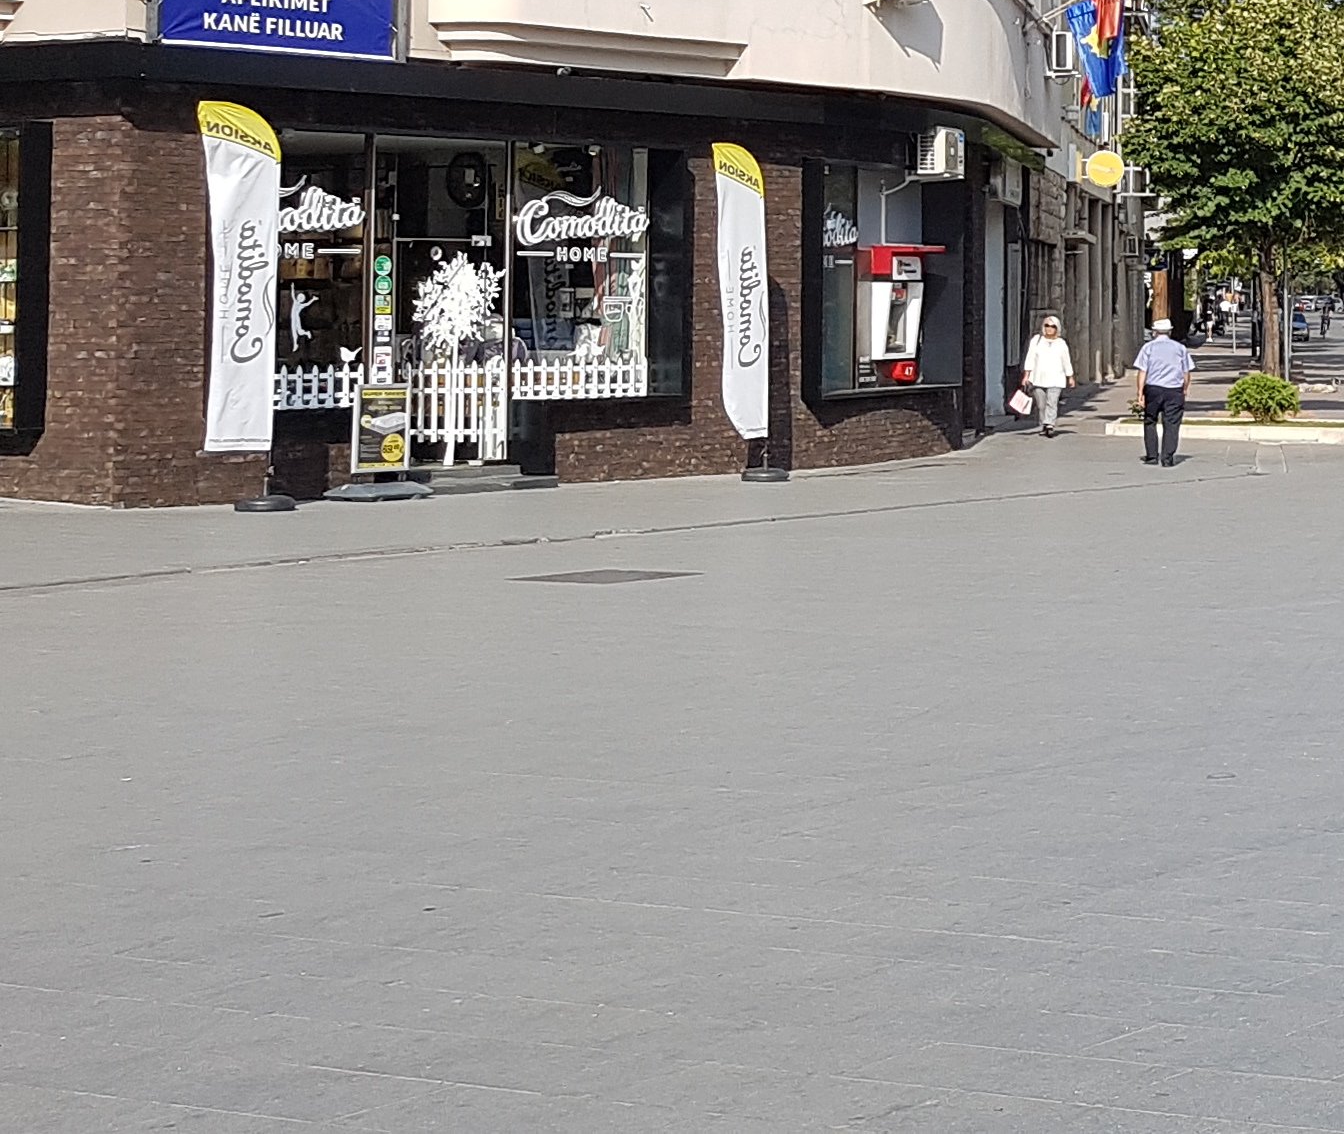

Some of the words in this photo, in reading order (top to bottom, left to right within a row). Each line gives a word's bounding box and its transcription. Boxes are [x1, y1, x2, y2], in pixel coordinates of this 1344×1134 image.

[203, 12, 260, 34] KANË
[266, 17, 344, 41] FILLUAR
[556, 246, 608, 262] HOME
